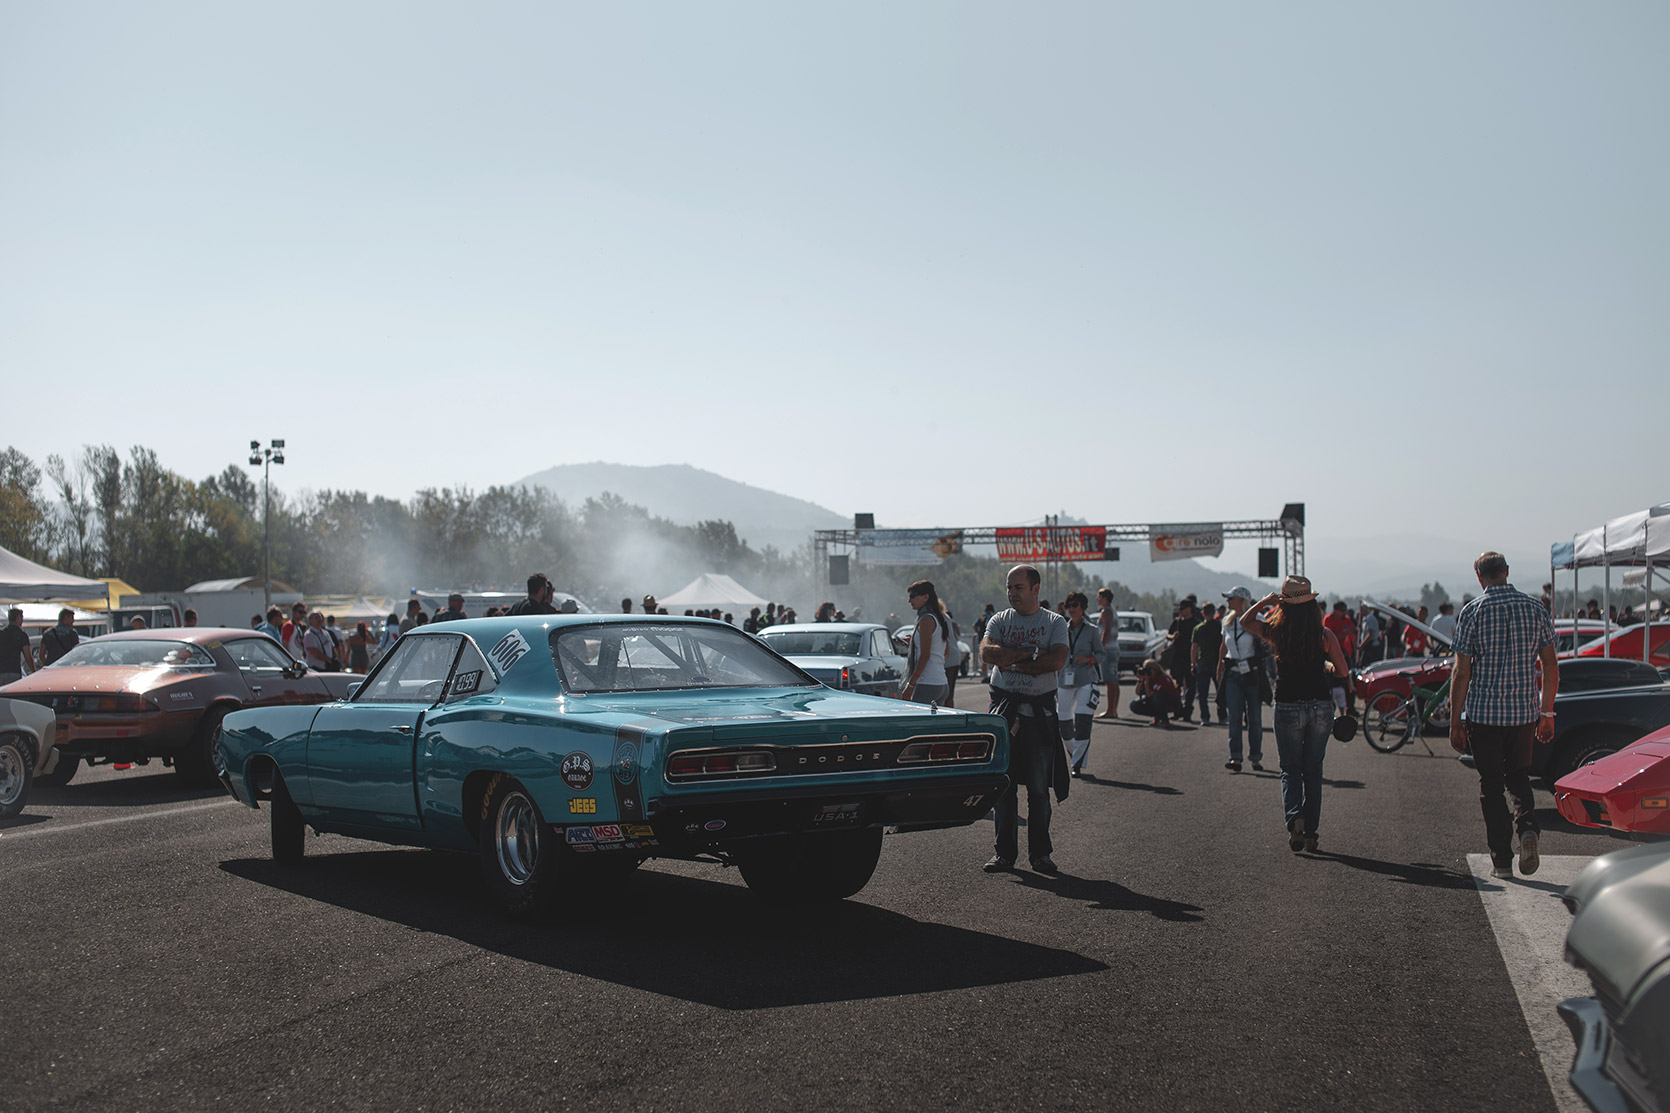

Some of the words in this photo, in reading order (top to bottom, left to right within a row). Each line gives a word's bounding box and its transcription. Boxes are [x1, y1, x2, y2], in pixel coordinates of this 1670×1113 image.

[1195, 536, 1220, 546] nolo
[492, 634, 526, 671] 606
[799, 752, 880, 764] DODGE
[568, 797, 597, 814] JEGS
[963, 794, 985, 807] 47
[593, 825, 621, 838] MSD
